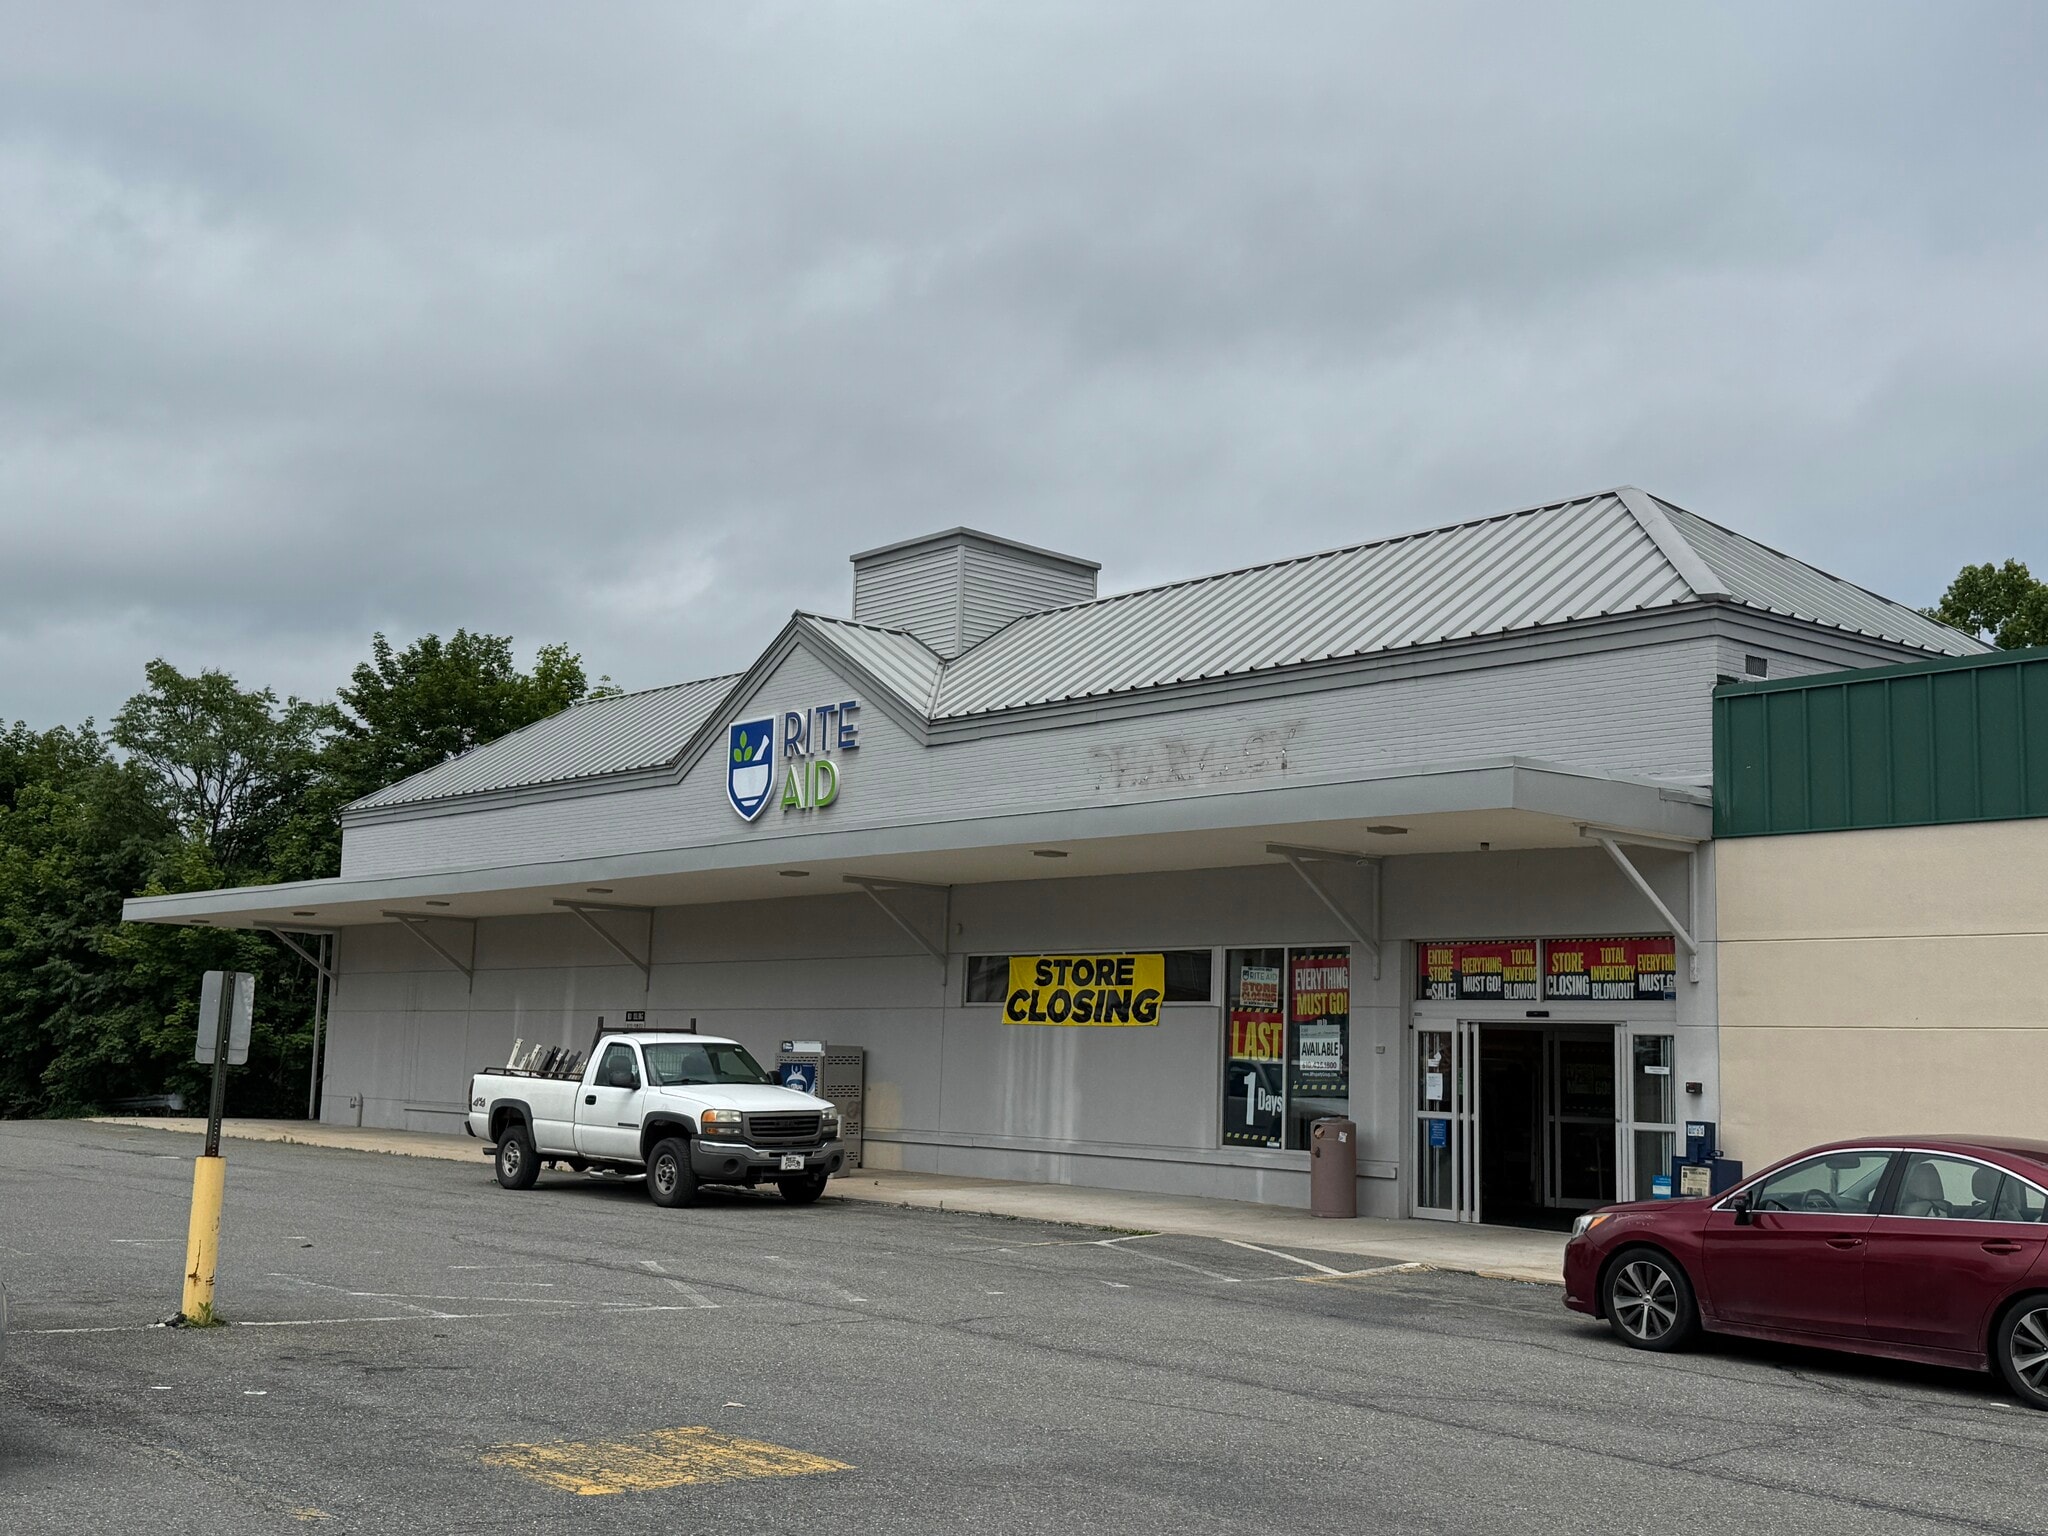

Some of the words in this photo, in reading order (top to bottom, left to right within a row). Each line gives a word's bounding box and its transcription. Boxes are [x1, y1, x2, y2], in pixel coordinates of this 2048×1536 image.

[783, 699, 860, 758] RITE
[780, 758, 838, 812] AID
[1427, 949, 1453, 965] ENTIRE
[1511, 949, 1535, 965] TOTAL
[1552, 952, 1584, 973] STORE
[1600, 947, 1626, 963] TOTAL
[1034, 957, 1136, 987] STORE
[1461, 957, 1502, 973] EVERYTHING
[1590, 965, 1636, 981] INVENTORY
[1250, 972, 1264, 981] RITE
[1265, 973, 1277, 981] AID
[1295, 967, 1348, 991] EVERYTHING
[1428, 966, 1453, 982] STORE
[1503, 966, 1536, 982] INVENTOR
[1242, 981, 1277, 993] STORE
[1431, 983, 1457, 1000] SALE!
[1463, 976, 1485, 992] MUST
[1486, 976, 1502, 992] GO!
[1504, 983, 1536, 1000] BLOWOU
[1546, 975, 1590, 996] CLOSING
[1592, 982, 1635, 1000] BLOWOUT
[1639, 974, 1665, 992] MUST
[1006, 988, 1161, 1023] CLOSING
[1242, 992, 1277, 1002] CLOSING
[1296, 992, 1327, 1015] MUST
[1328, 992, 1348, 1014] GO!
[1232, 1020, 1283, 1062] LAST
[1301, 1041, 1339, 1057] AVAILABLE
[1243, 1071, 1256, 1126] 1
[1257, 1087, 1282, 1116] Days
